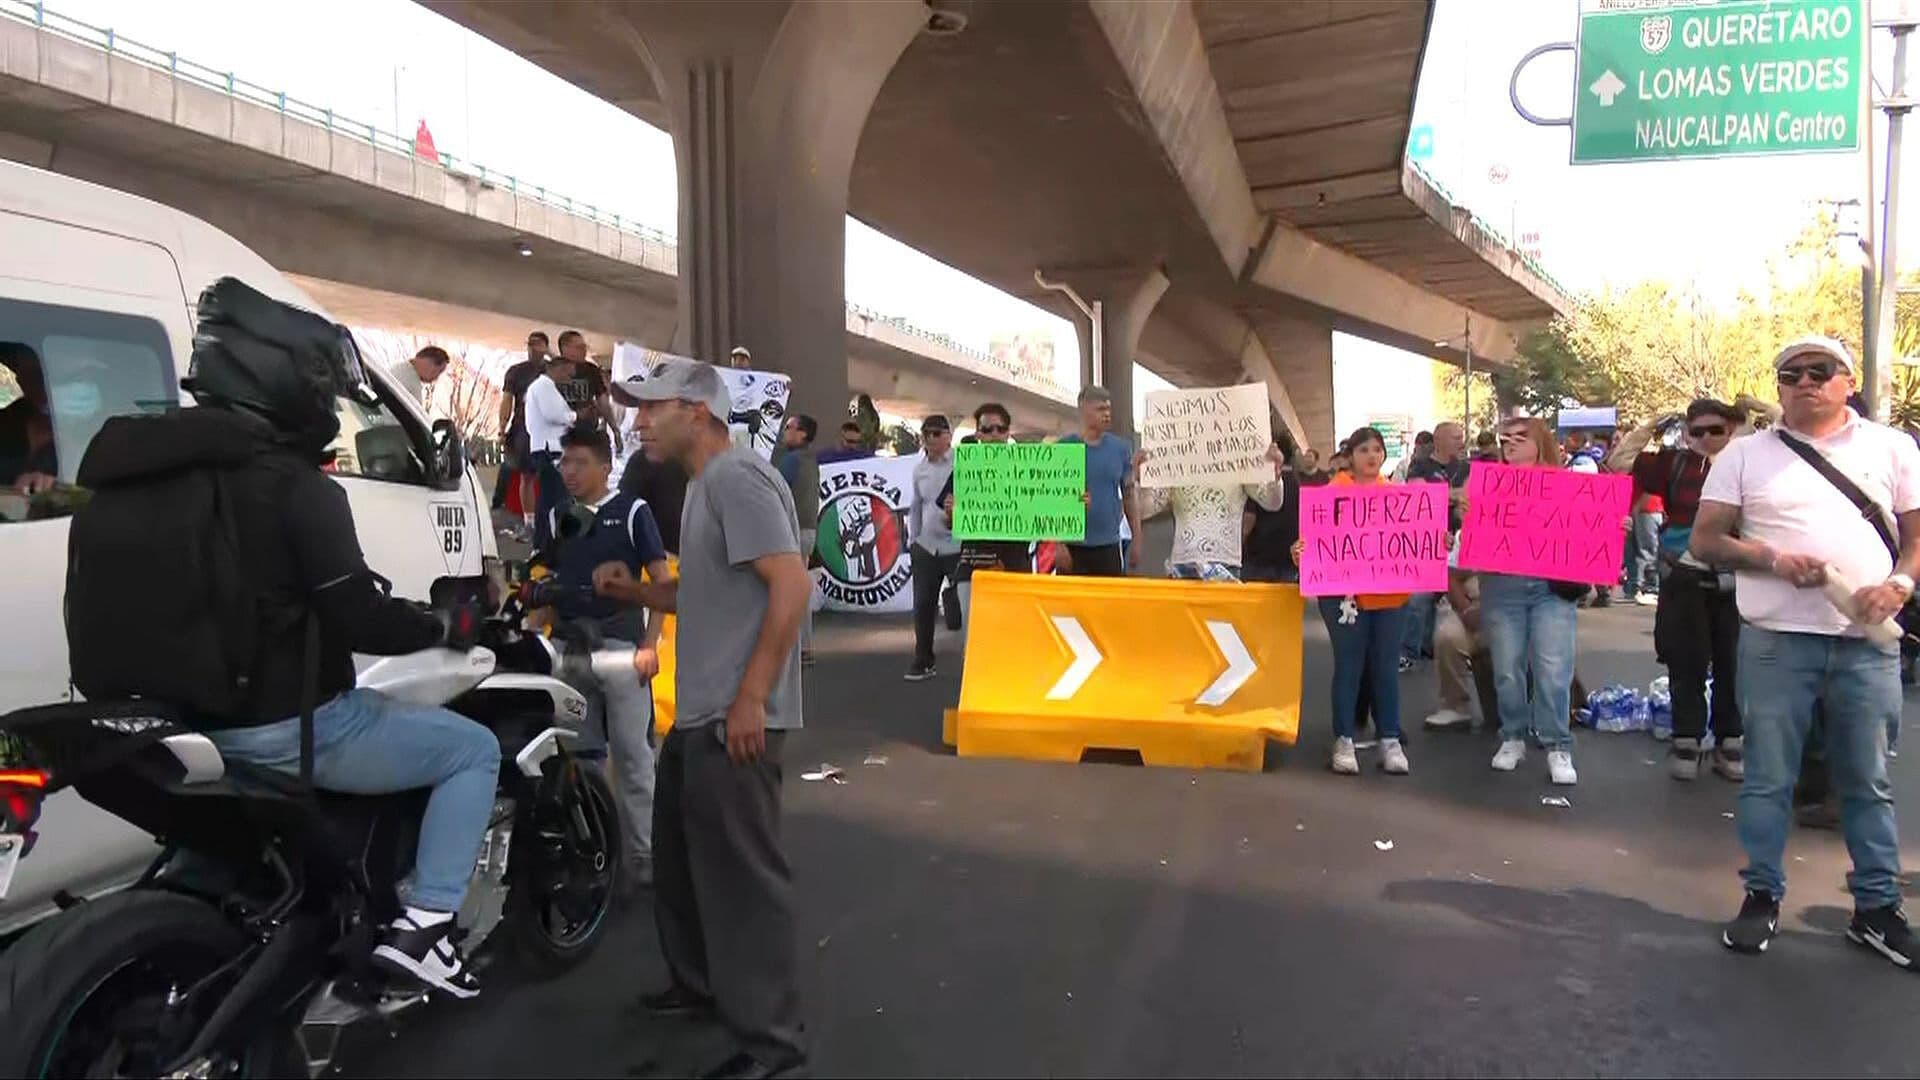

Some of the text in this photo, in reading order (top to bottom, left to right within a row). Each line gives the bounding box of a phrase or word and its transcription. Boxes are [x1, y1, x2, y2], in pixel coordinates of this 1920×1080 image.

[1647, 30, 1663, 45] 57
[1682, 2, 1852, 48] QUERÉTARO
[1638, 57, 1850, 100] LOMAS VERDES
[1635, 112, 1846, 149] NAUCALPAN Centro
[1213, 420, 1223, 433] A
[1229, 416, 1257, 433] LOS
[957, 446, 977, 462] NO
[819, 471, 902, 506] UERZA
[436, 506, 466, 528] RUTA
[444, 529, 463, 553] 89
[1317, 528, 1446, 564] NACIONAL
[818, 564, 913, 606] NACIONAL
